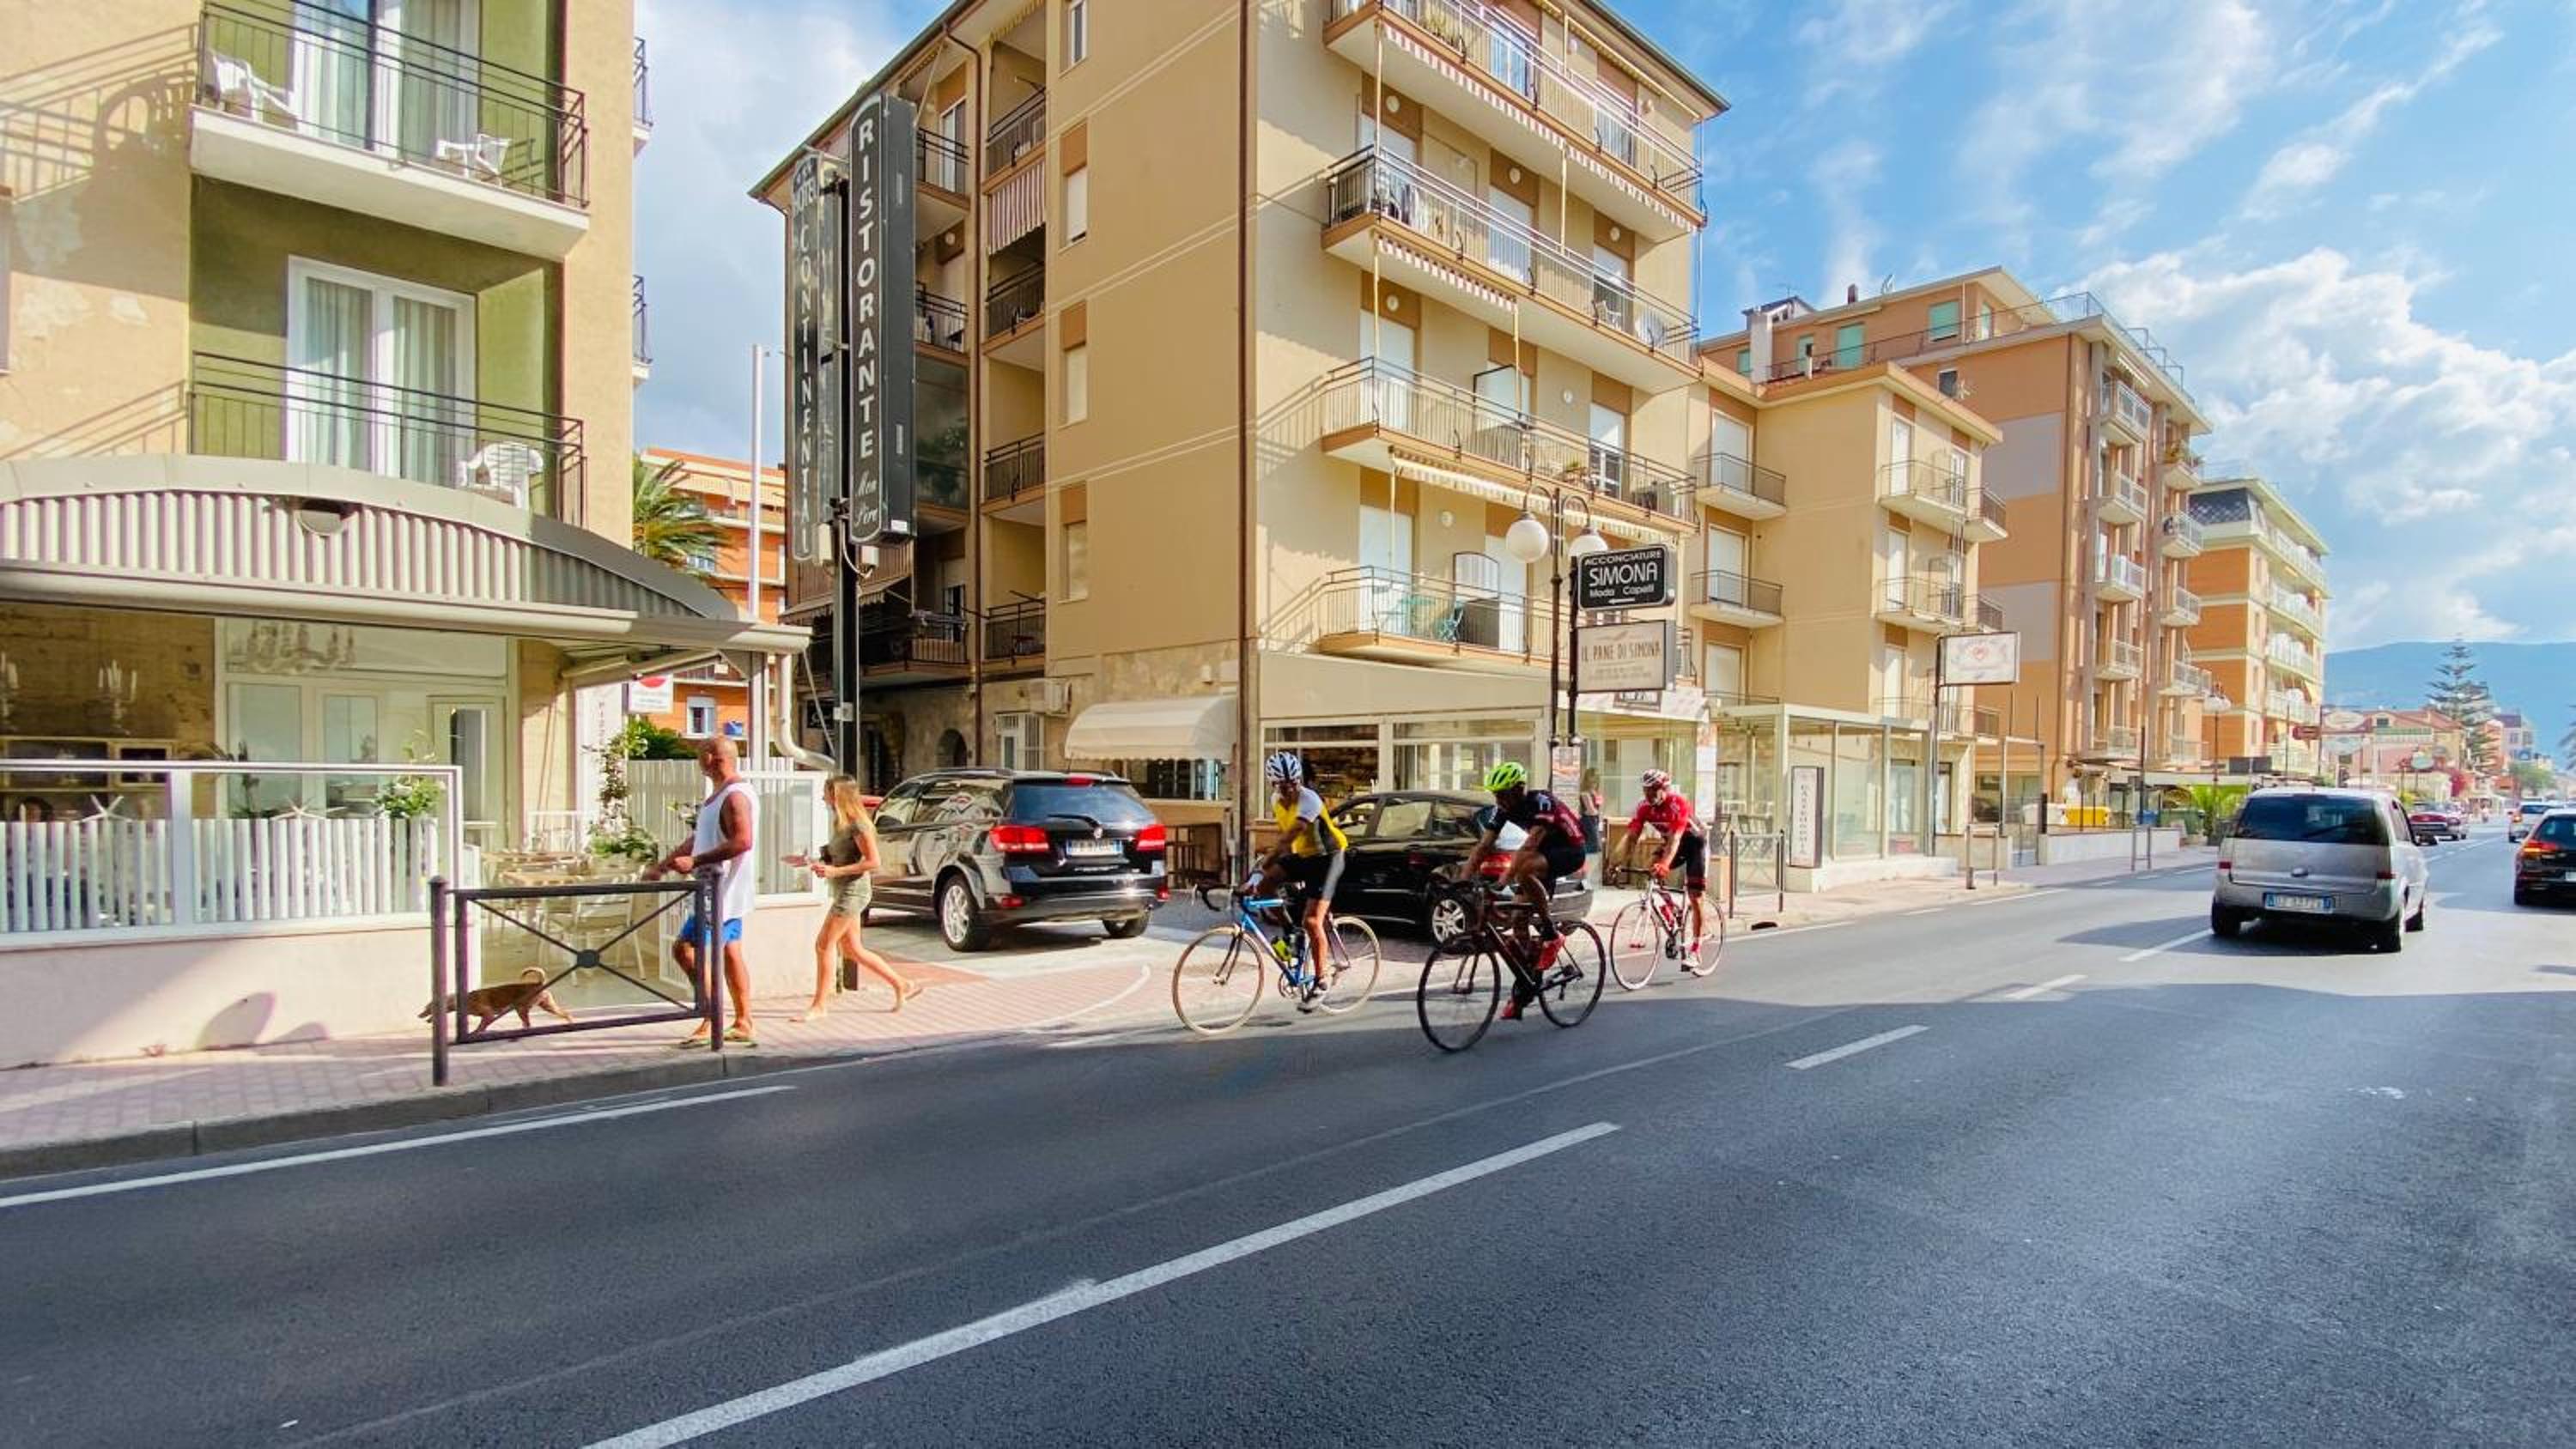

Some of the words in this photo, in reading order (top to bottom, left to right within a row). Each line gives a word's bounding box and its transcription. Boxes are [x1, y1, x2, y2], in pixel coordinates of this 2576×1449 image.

[857, 118, 876, 459] RISTORANTE
[799, 224, 811, 554] CONTINENTAL
[1584, 551, 1662, 566] ACCONCIATURE
[1589, 561, 1658, 587] SIMONA
[1589, 588, 1614, 597] Moda
[1581, 646, 1589, 662] IL
[1593, 645, 1614, 660] PANE
[1618, 643, 1627, 659] DI
[1629, 640, 1662, 659] SIMONA
